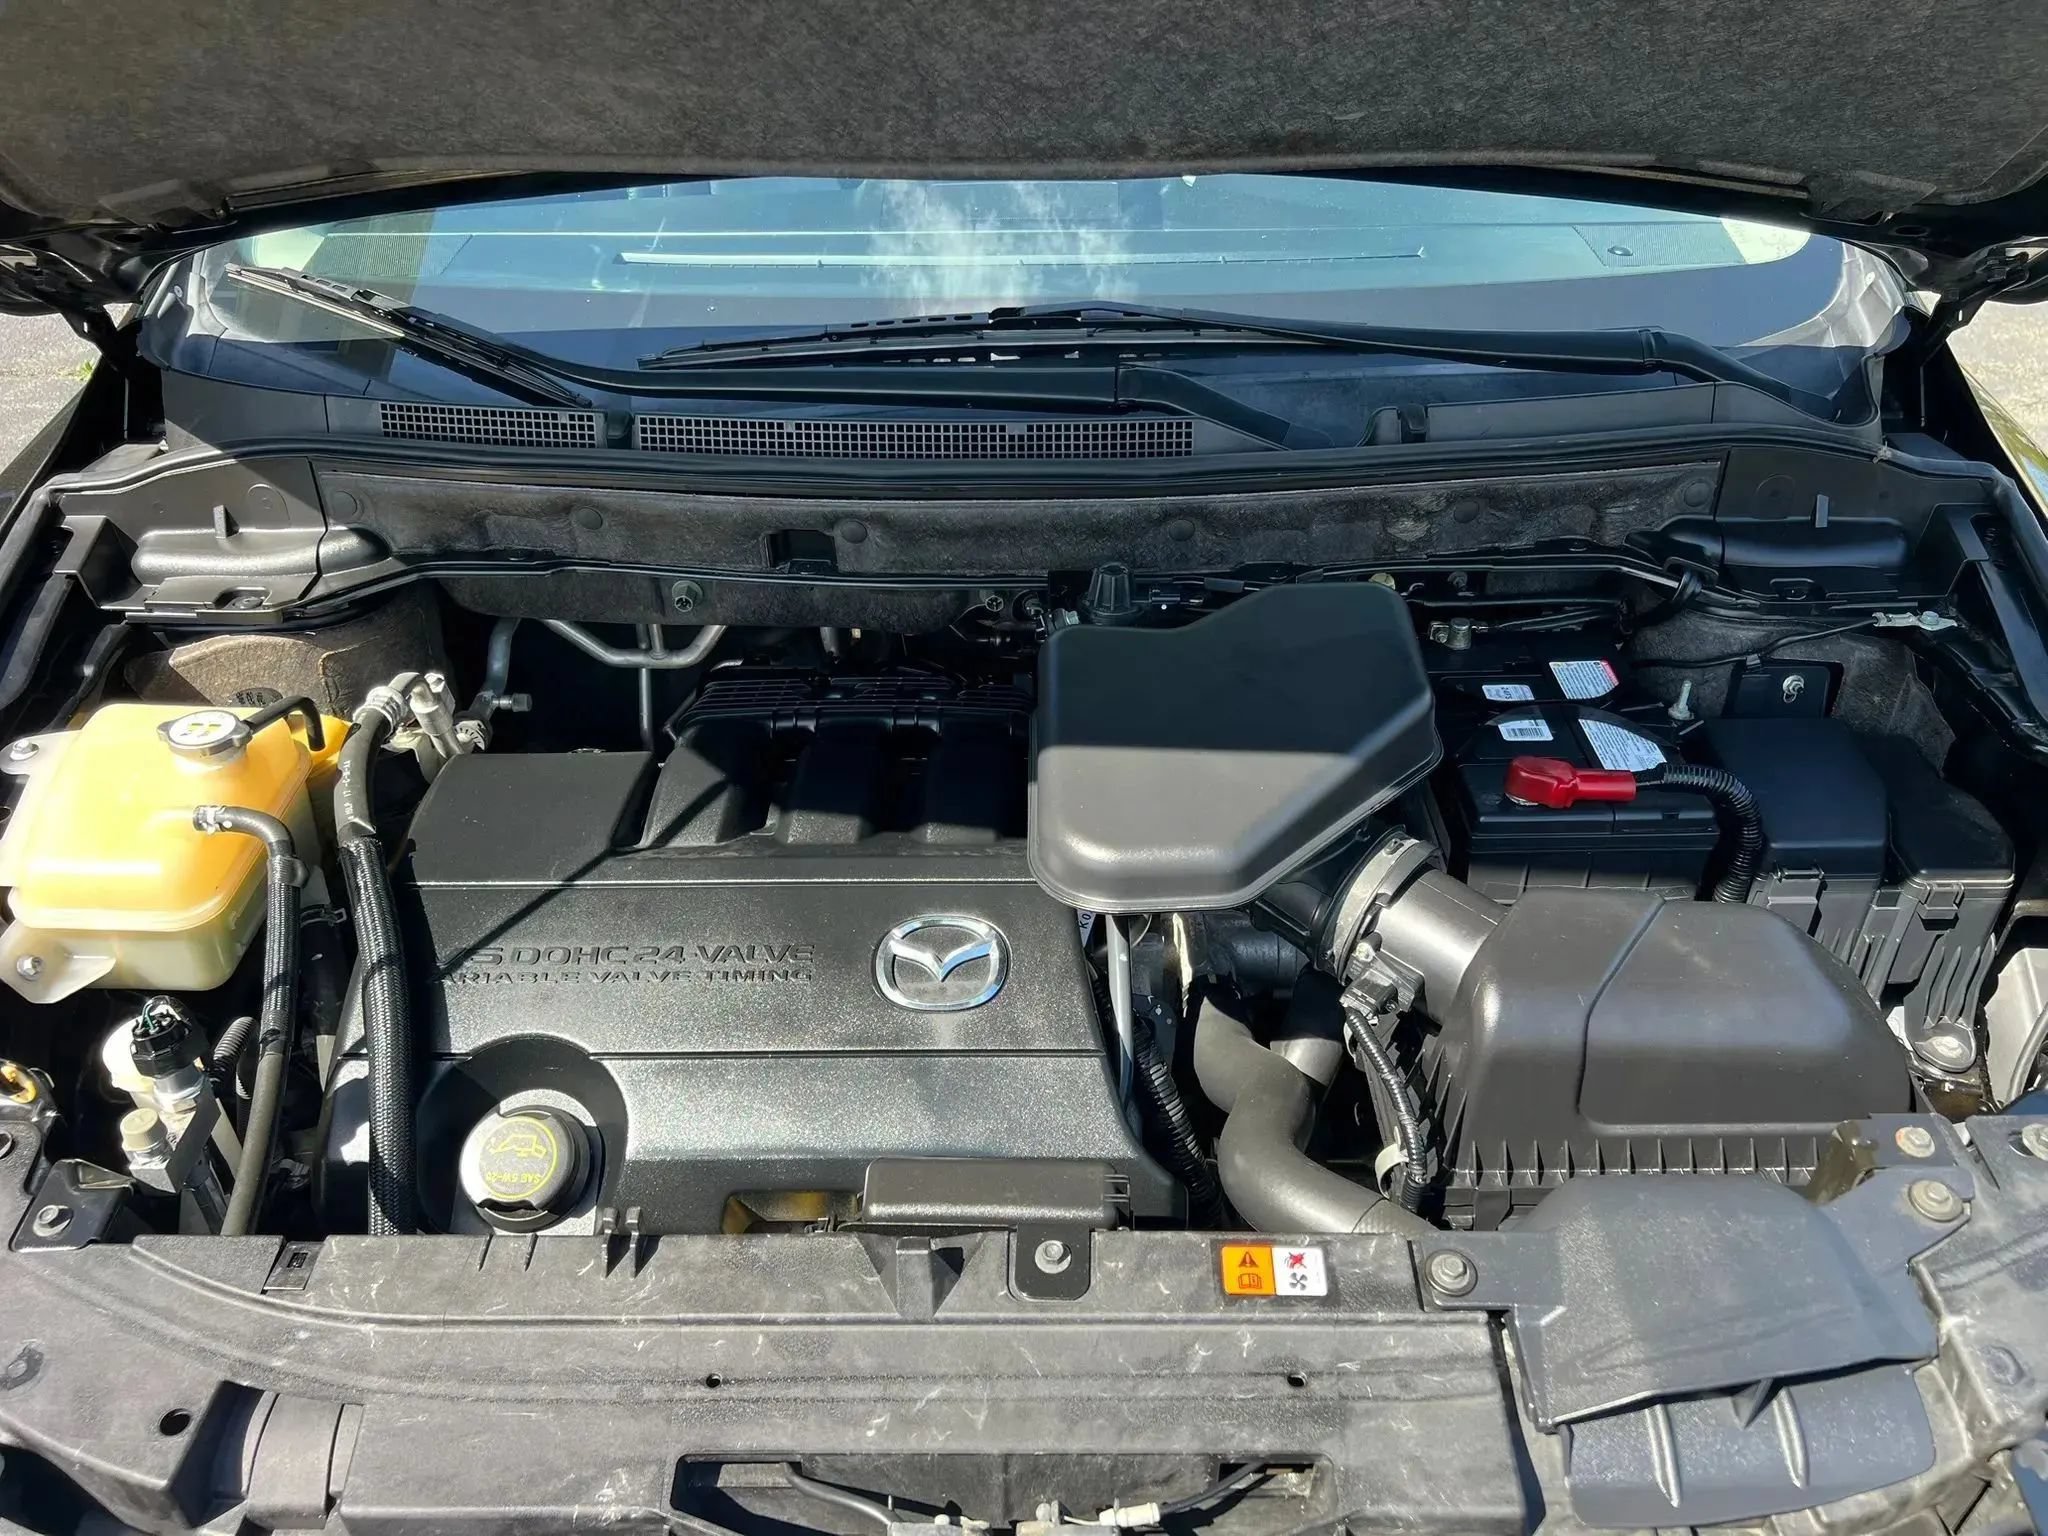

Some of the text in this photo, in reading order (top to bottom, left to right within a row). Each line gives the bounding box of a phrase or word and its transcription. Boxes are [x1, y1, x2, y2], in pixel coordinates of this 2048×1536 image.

[509, 945, 629, 966] DOHC
[437, 968, 814, 985] ARIABLE VALVE TIMING
